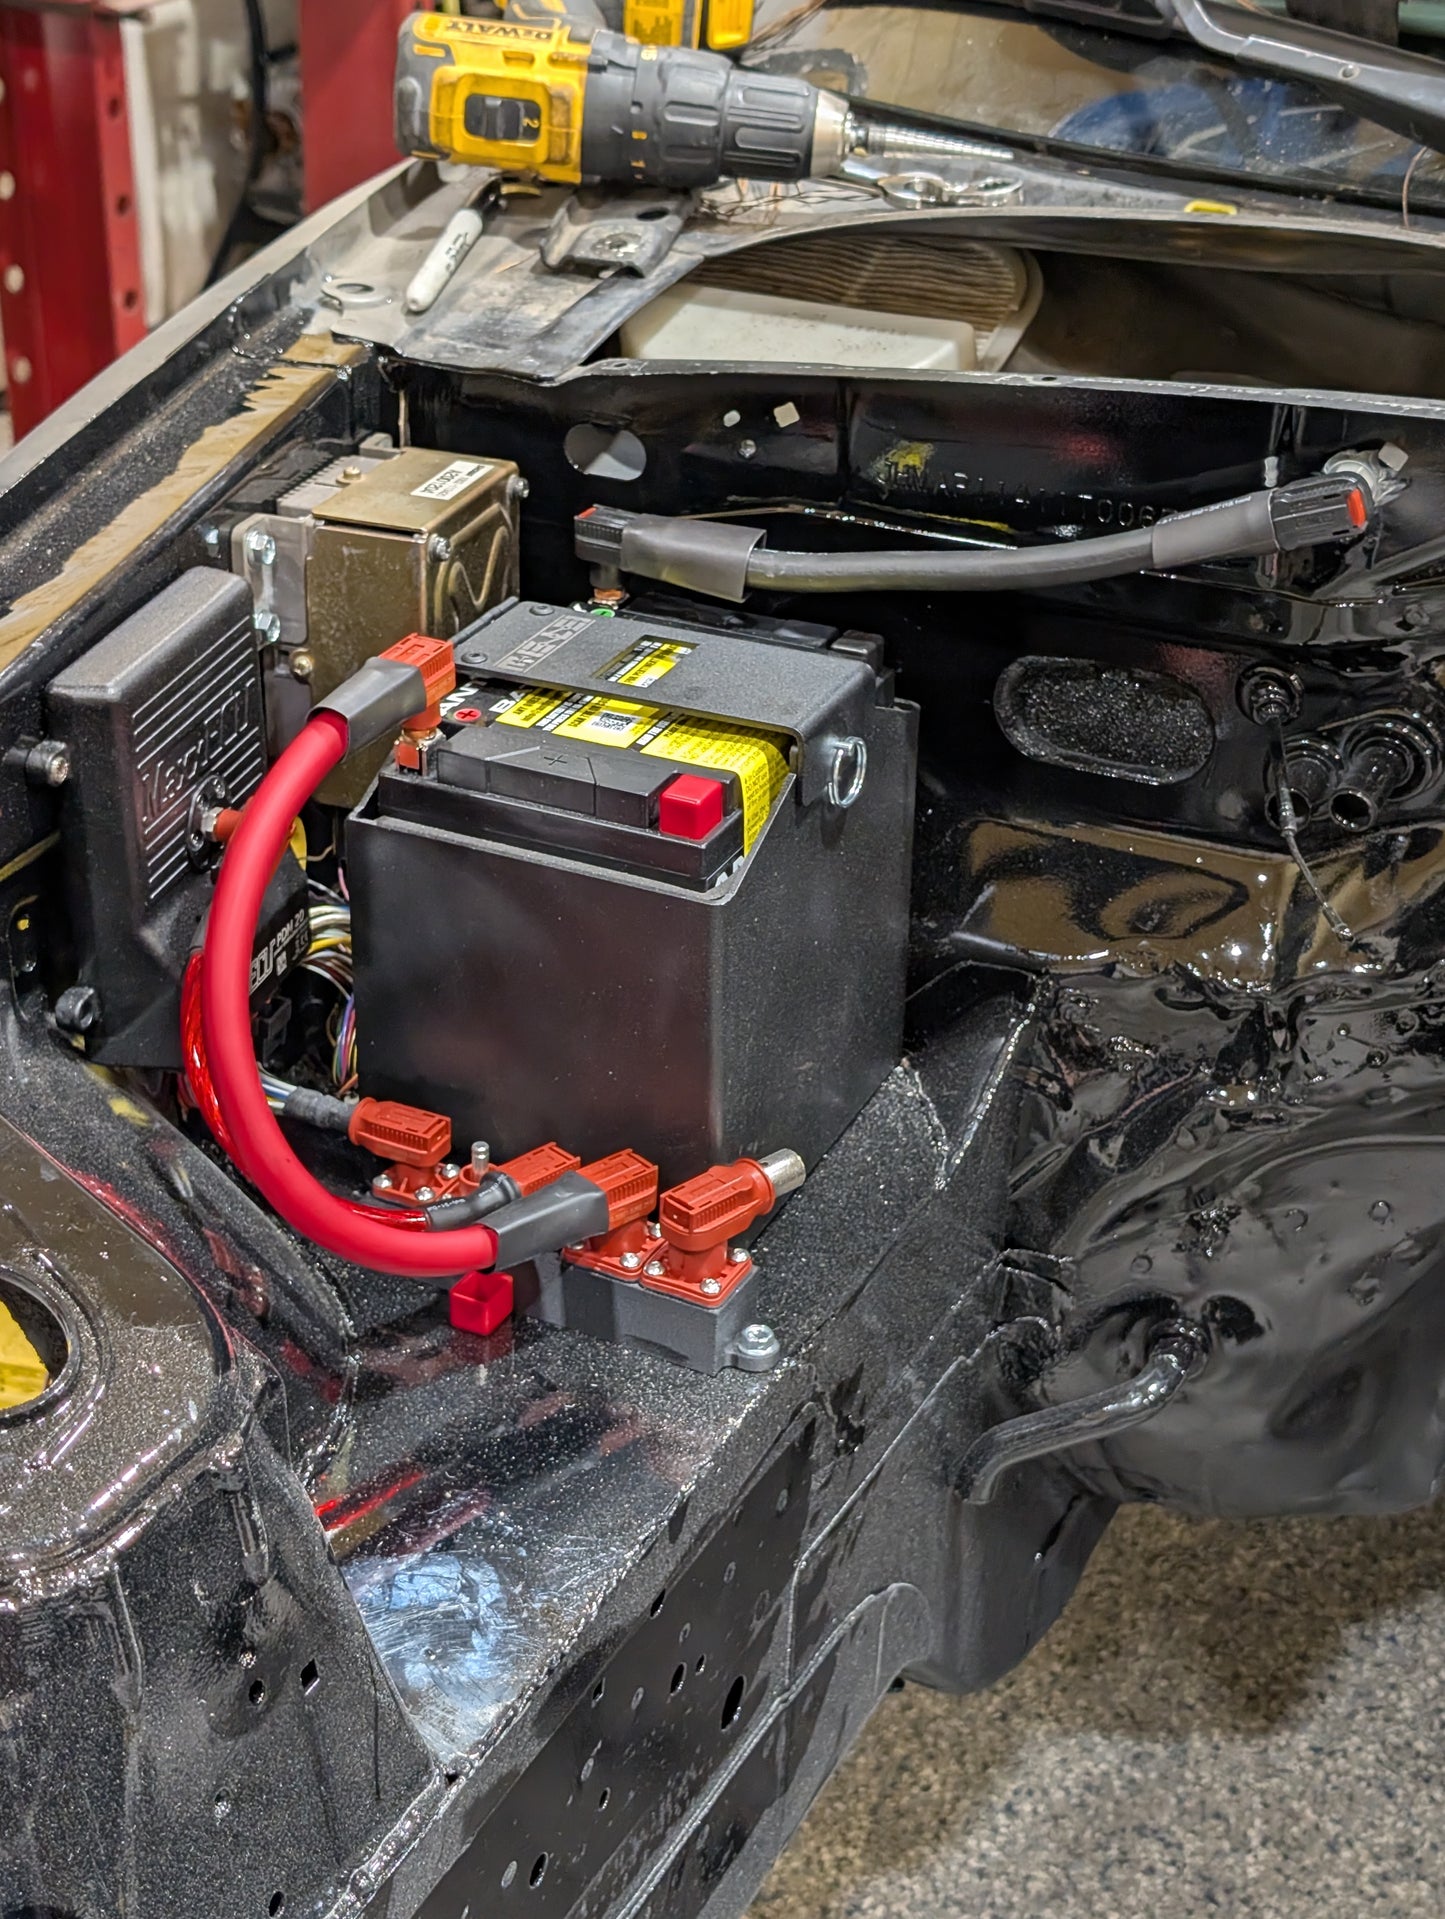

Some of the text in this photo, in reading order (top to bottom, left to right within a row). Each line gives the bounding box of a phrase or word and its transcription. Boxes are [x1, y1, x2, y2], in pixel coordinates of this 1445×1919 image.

[447, 19, 553, 42] DEWALT
[522, 116, 540, 130] 2
[276, 918, 295, 948] PDM
[294, 907, 305, 928] 20
